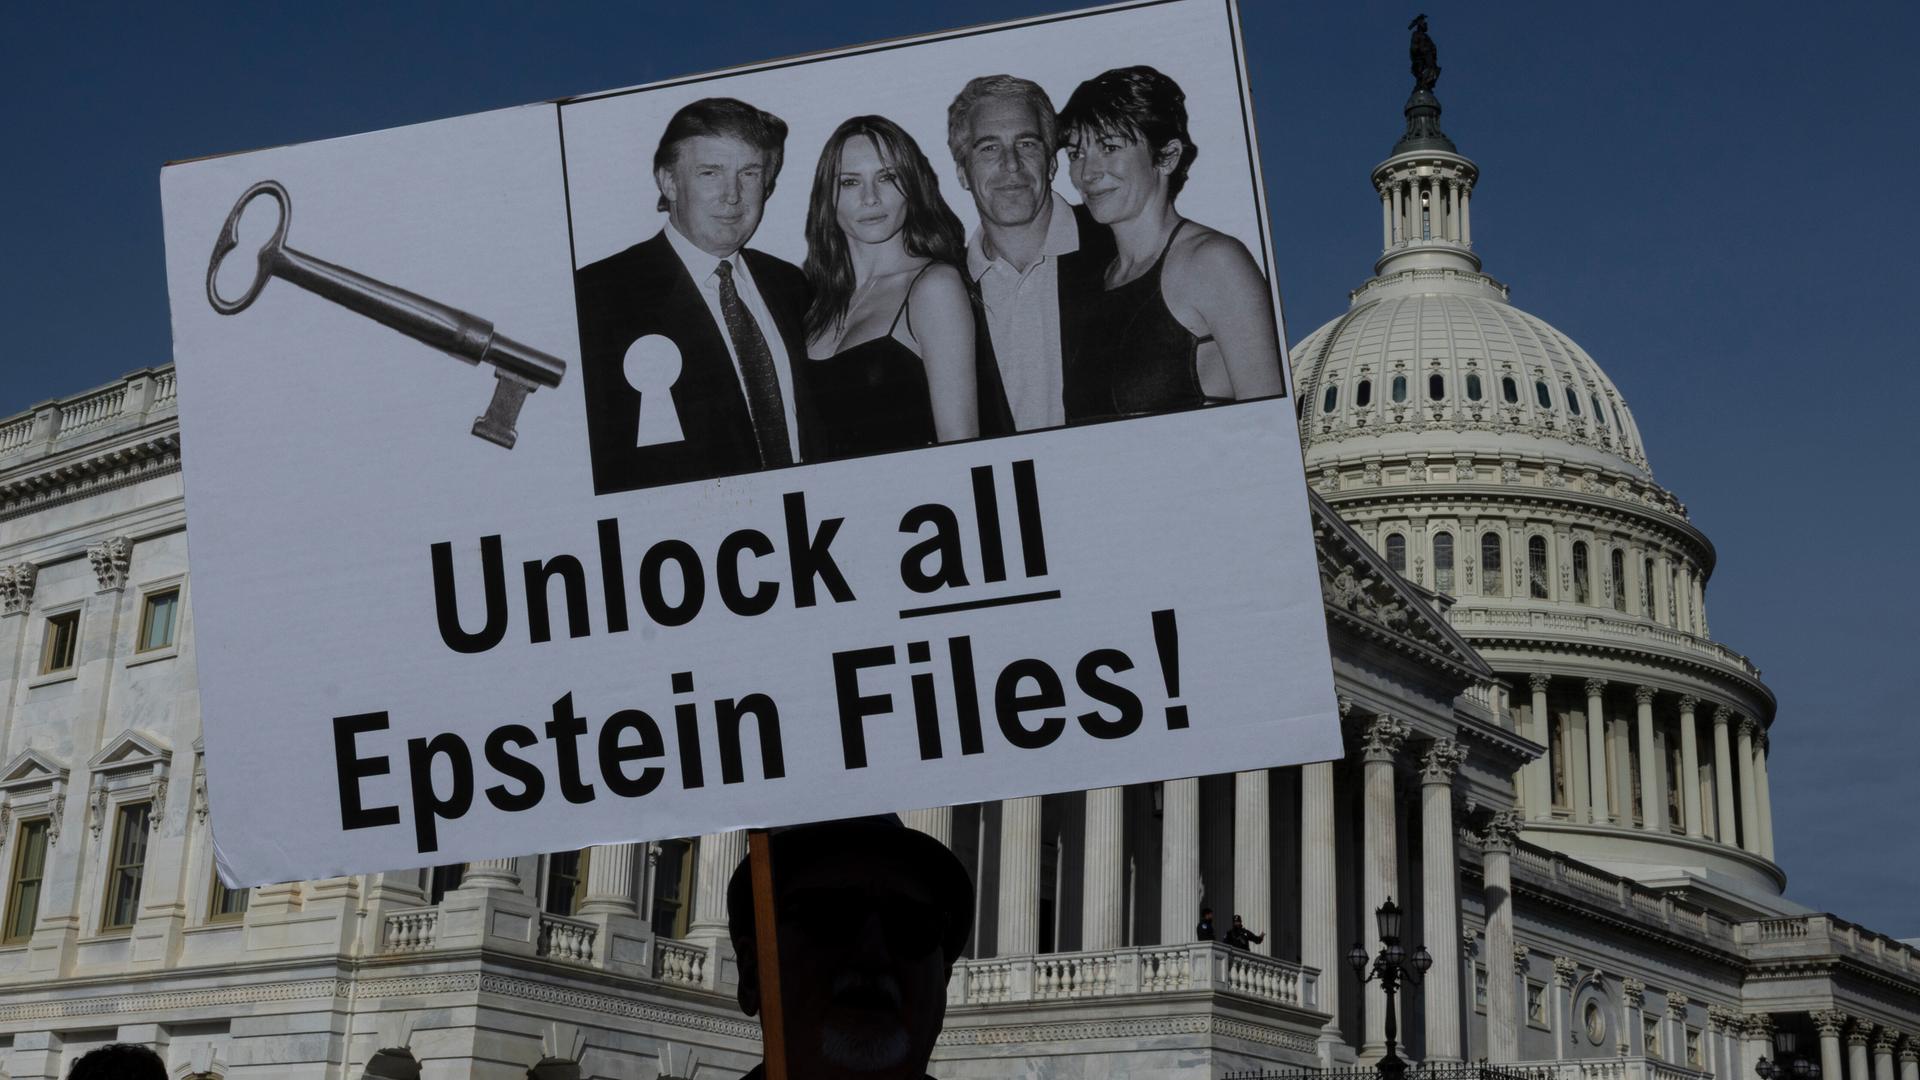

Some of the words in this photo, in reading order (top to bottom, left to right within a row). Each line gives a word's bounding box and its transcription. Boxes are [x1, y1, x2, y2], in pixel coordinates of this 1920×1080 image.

[431, 491, 857, 654] Unlock
[899, 459, 1049, 594] all
[333, 671, 786, 853] Epstein
[832, 608, 1190, 771] Files!
